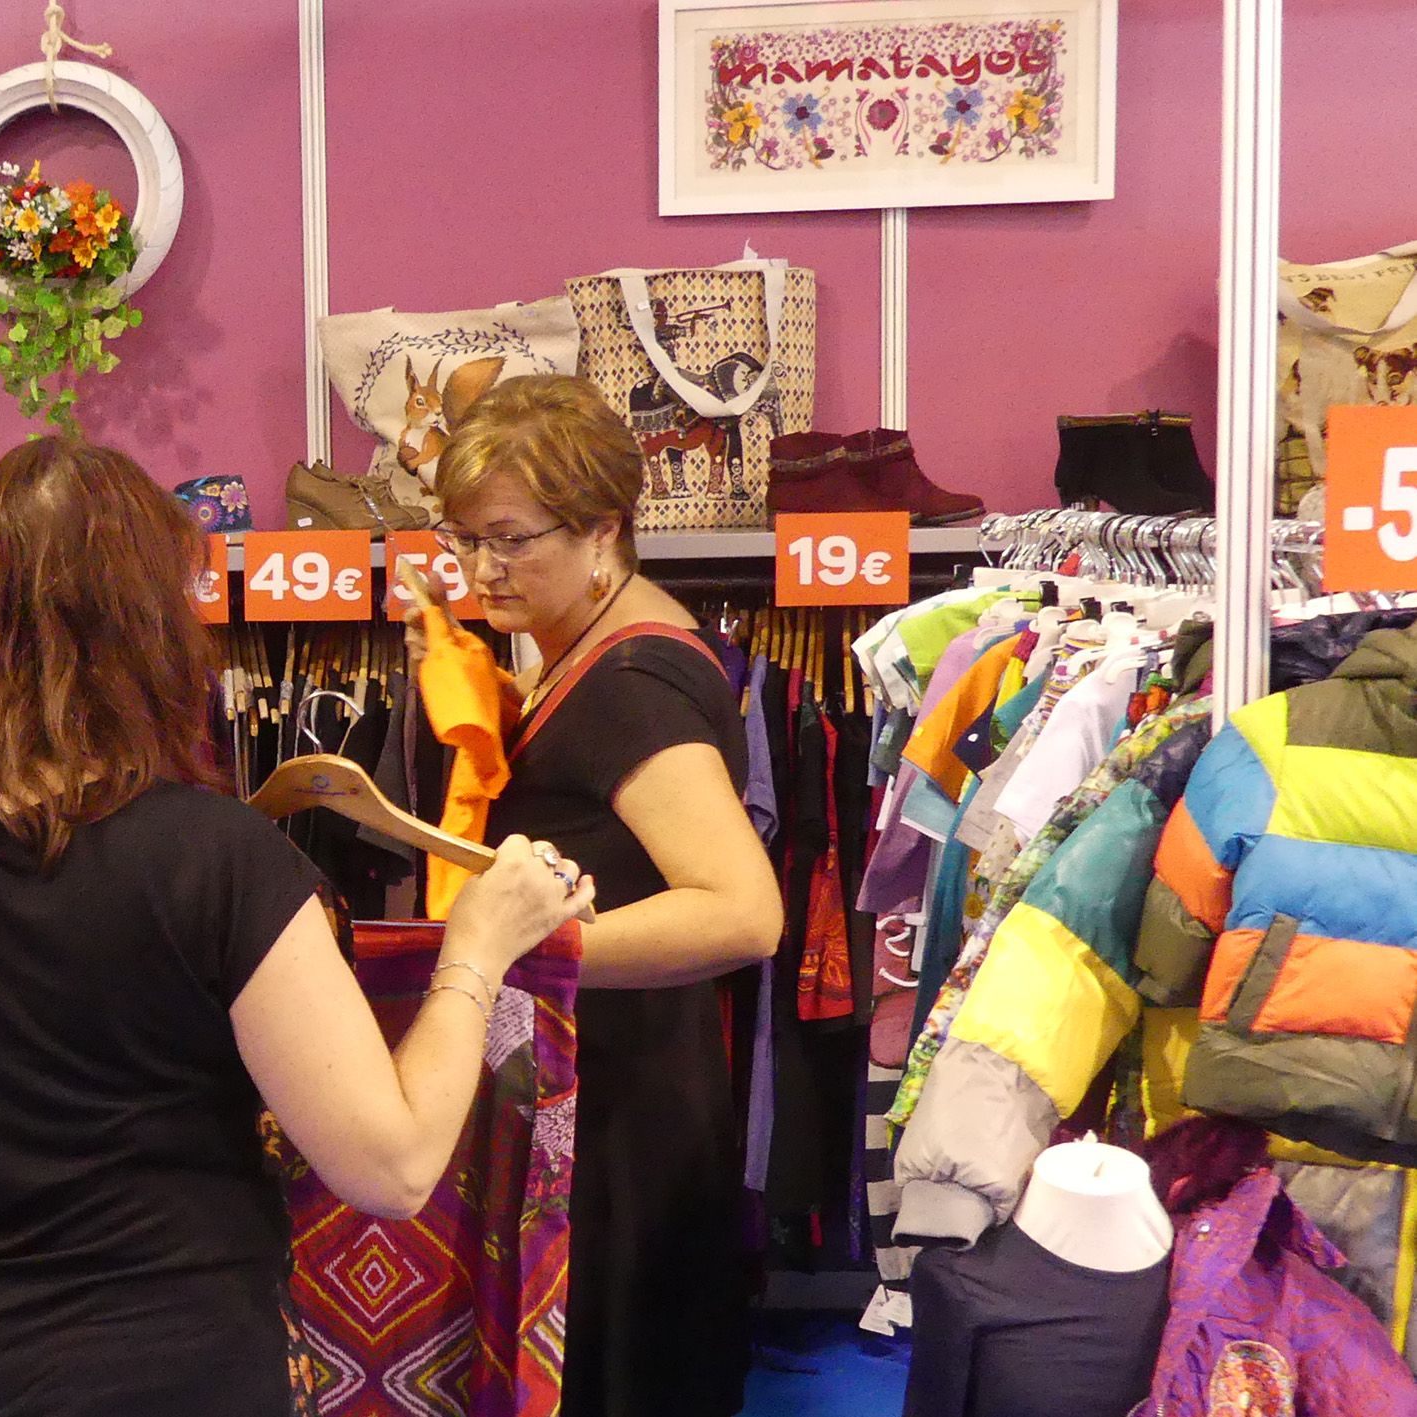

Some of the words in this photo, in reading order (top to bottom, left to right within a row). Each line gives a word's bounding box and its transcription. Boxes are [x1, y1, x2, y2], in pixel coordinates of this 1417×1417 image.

[249, 552, 363, 601] 49€
[393, 553, 469, 602] 59
[788, 535, 892, 586] 19€
